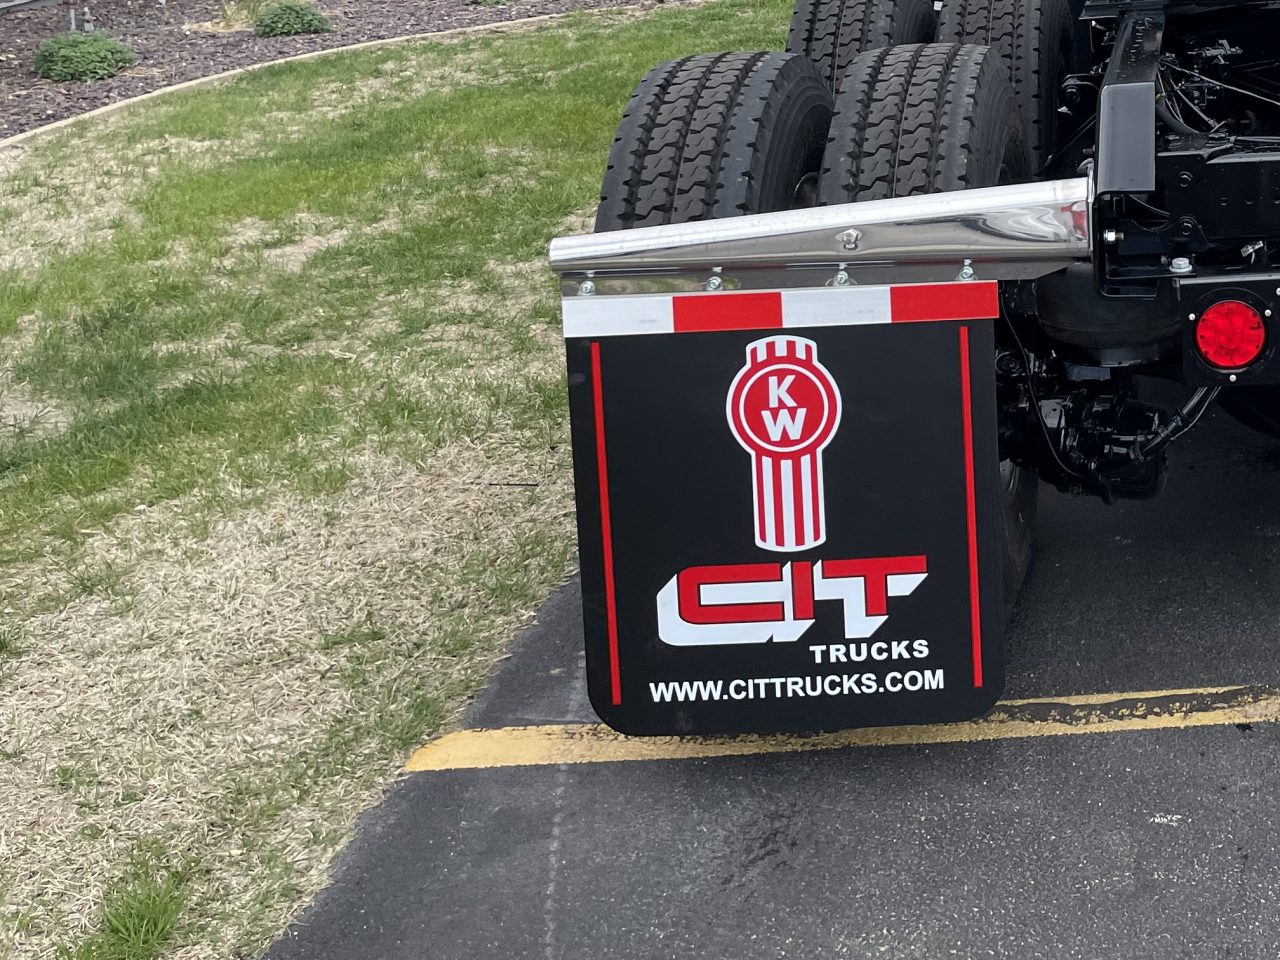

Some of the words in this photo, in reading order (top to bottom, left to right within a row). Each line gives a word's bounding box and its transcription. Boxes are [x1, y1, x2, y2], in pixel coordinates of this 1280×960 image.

[656, 555, 928, 646] CIT
[809, 639, 930, 664] TRUCKS
[649, 669, 945, 704] WWW.CITTRUCKS.COM
